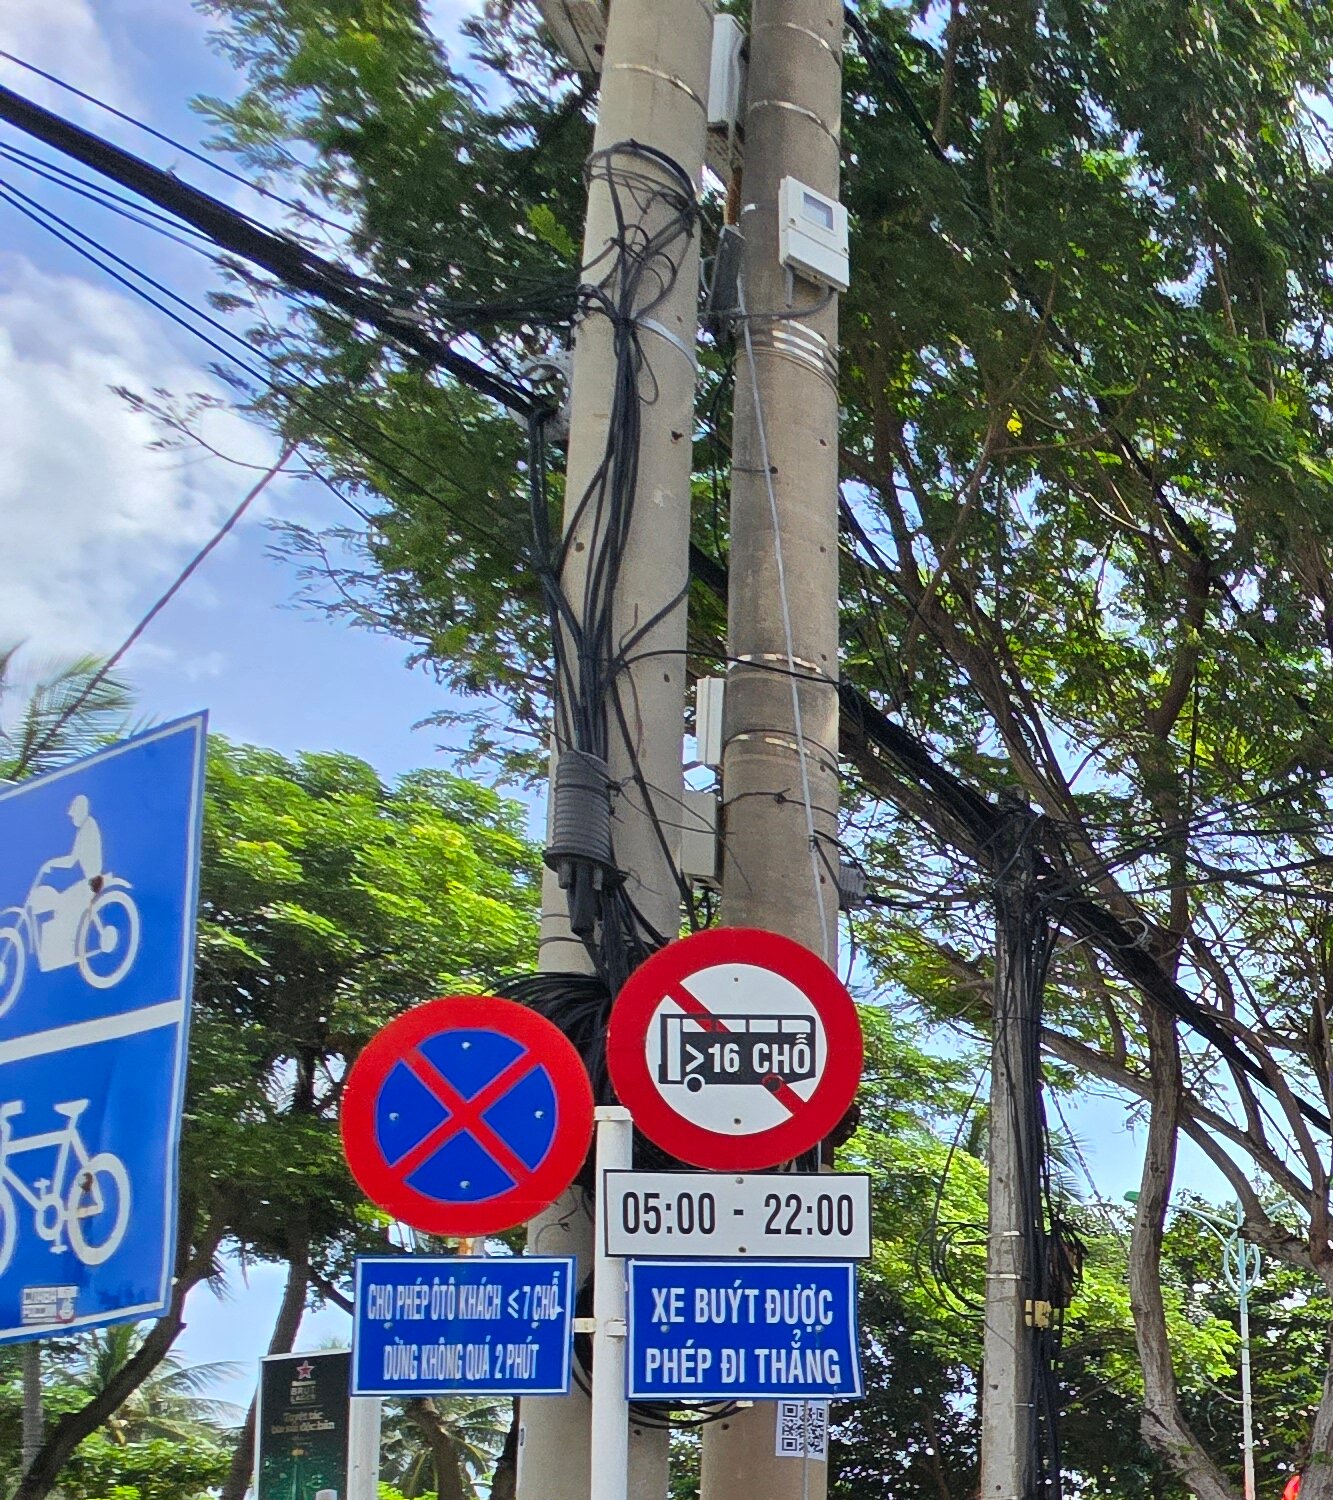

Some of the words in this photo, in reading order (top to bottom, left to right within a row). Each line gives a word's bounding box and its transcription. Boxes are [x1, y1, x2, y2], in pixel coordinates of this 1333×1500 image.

[752, 1033, 811, 1074] CHỖ
[622, 1191, 716, 1235] 05:00
[764, 1193, 854, 1236] 22:00
[367, 1283, 393, 1320] CHO
[396, 1277, 430, 1320] PHÉP
[431, 1276, 456, 1320] ÔTÔ
[459, 1276, 502, 1320] KHÁCH
[532, 1270, 561, 1320] CHỖ
[651, 1287, 685, 1323] XE
[695, 1279, 760, 1324] BUÝT
[765, 1283, 833, 1333] ĐƯỢC
[383, 1336, 419, 1380] DỪNG
[420, 1336, 463, 1380] KHÔNG
[465, 1335, 491, 1381] QUÁ
[495, 1343, 503, 1379] 2
[505, 1336, 540, 1379] PHÚT
[645, 1339, 712, 1384] PHÉP
[720, 1348, 746, 1384] ĐI
[755, 1329, 842, 1385] THẲNG
